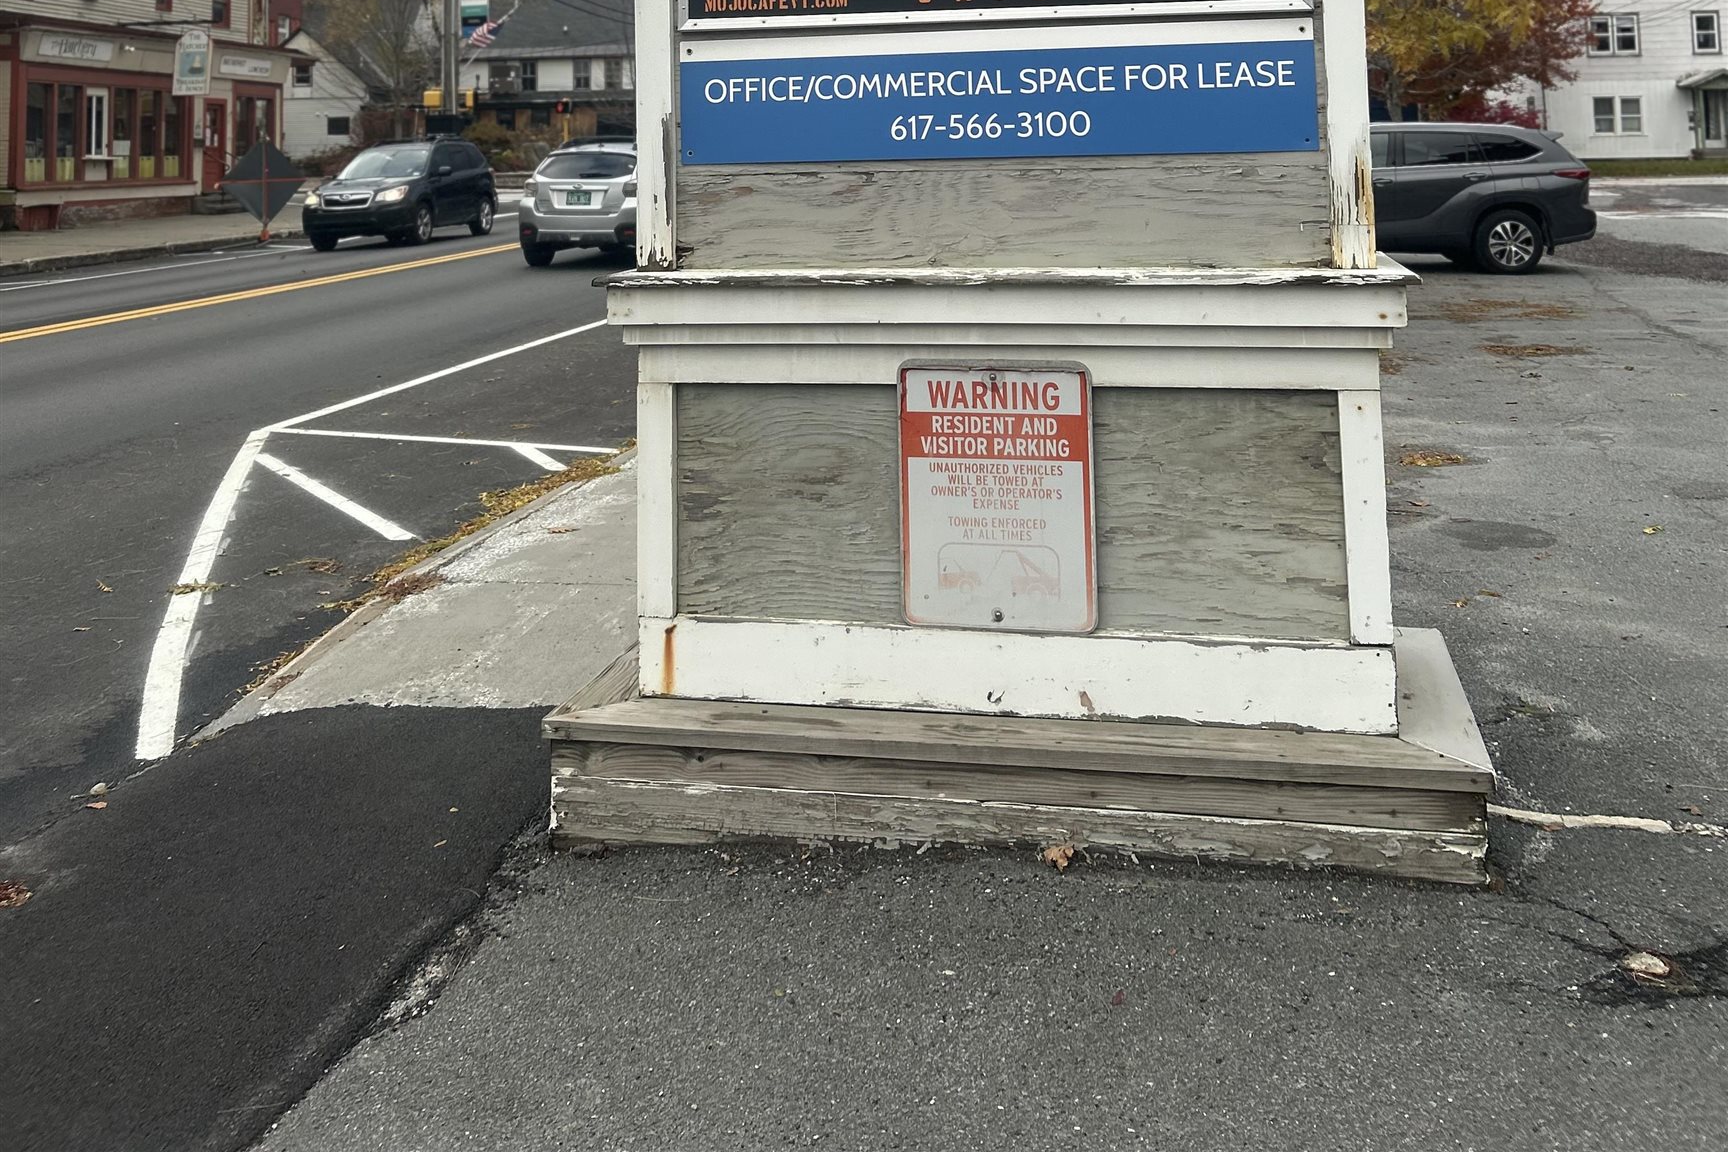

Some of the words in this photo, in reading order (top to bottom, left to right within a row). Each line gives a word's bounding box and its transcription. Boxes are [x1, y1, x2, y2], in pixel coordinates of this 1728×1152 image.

[704, 69, 1012, 104] OFFICE/COMMERCIAL
[1019, 66, 1116, 94] SPACE
[1124, 63, 1189, 91] FOR
[1197, 60, 1296, 89] LEASE
[890, 110, 1091, 141] 617-566-3100
[928, 380, 1060, 411] WARNING
[932, 415, 1015, 434] RESIDENT
[1021, 418, 1057, 435] AND
[921, 436, 987, 455] VISITOR
[993, 438, 1070, 457] PARKING
[929, 462, 1009, 474] UNAUTHORIZED
[1013, 464, 1063, 476] VEHICLES
[948, 474, 971, 485] WILL
[976, 475, 988, 486] BE
[992, 476, 1027, 487] TOWED
[1031, 477, 1044, 487] AT
[931, 485, 977, 497] OWNER'S
[981, 487, 994, 497] OR
[998, 487, 1062, 499] OPERATOR'S
[973, 499, 1020, 510] EXPENSE
[948, 516, 988, 528] TOWING
[992, 518, 1046, 530] ENFORCED
[963, 529, 976, 539] AT
[978, 530, 997, 540] ALL
[1000, 530, 1032, 541] TIMES
